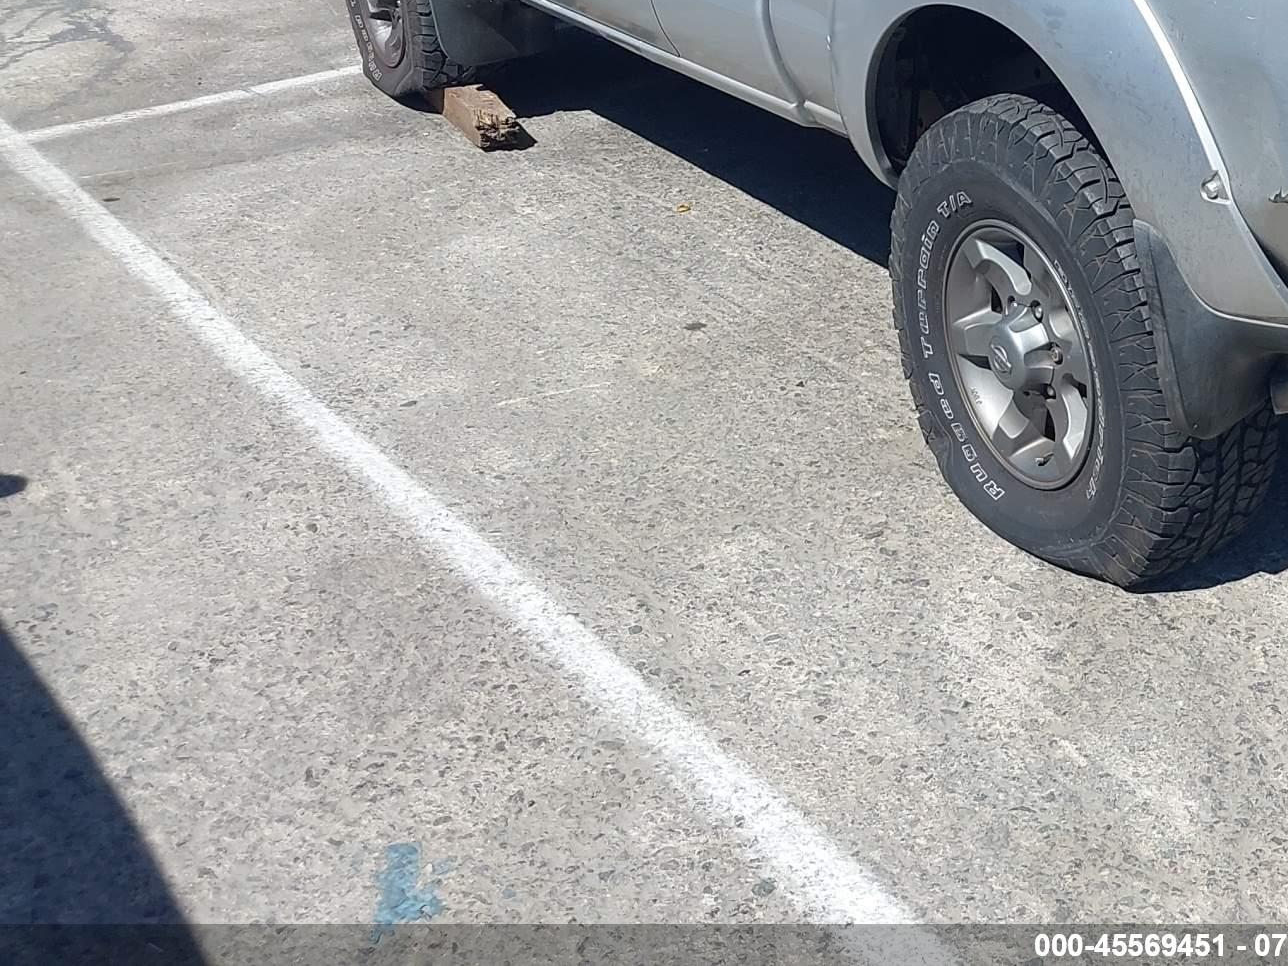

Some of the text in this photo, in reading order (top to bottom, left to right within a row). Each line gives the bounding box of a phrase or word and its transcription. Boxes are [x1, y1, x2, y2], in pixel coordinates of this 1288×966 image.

[916, 190, 1006, 501] Rugged Terrain T/A
